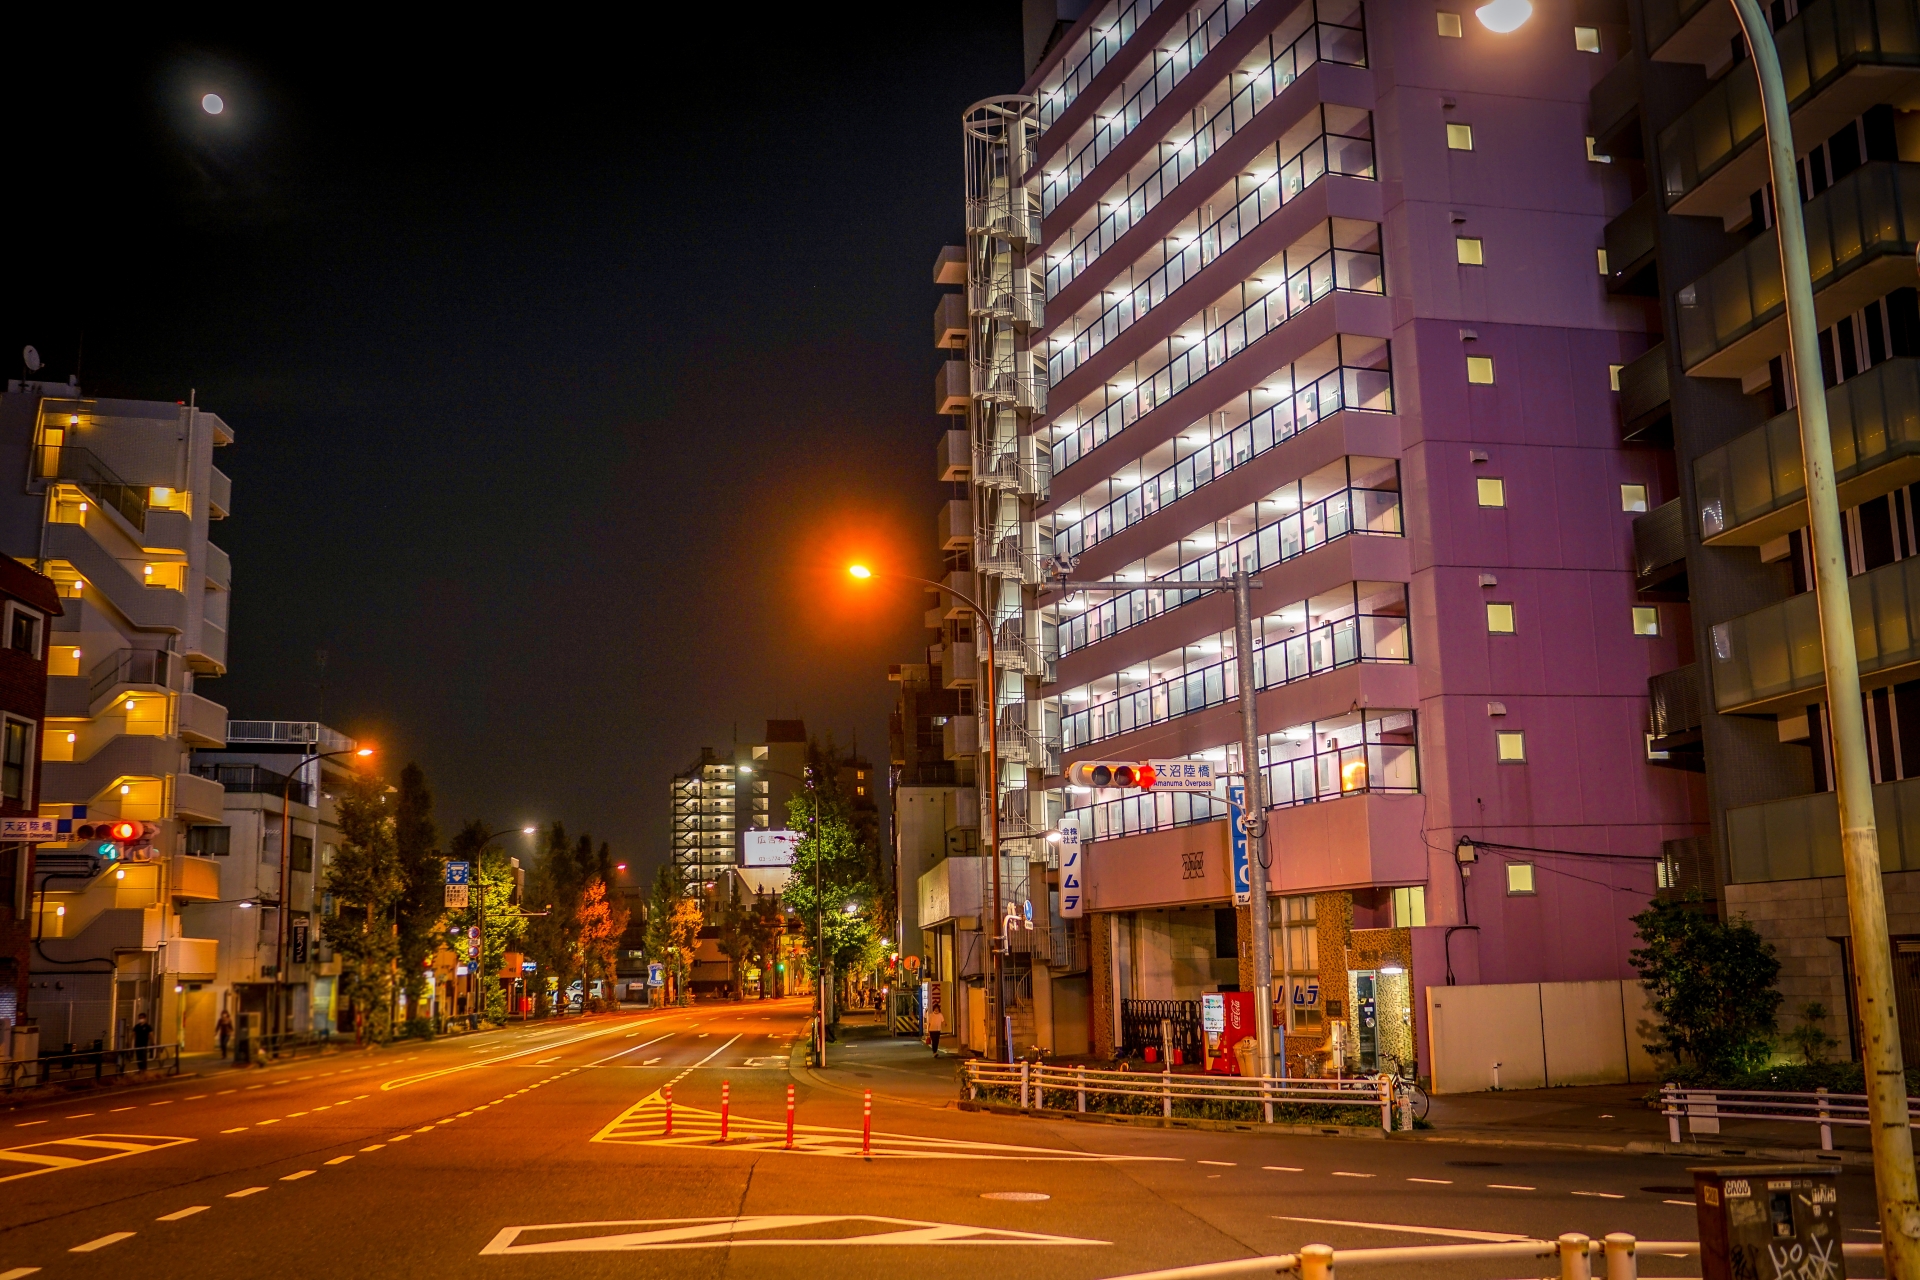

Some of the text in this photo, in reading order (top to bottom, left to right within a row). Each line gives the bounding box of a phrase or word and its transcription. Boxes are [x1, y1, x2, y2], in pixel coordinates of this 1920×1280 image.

[1155, 764, 1210, 777] 天沼陸橋
[1185, 780, 1212, 788] Overpass
[5, 821, 52, 831] 天沼陸橋
[1063, 852, 1080, 910] ノムラ
[1274, 985, 1318, 1004] ノムラ
